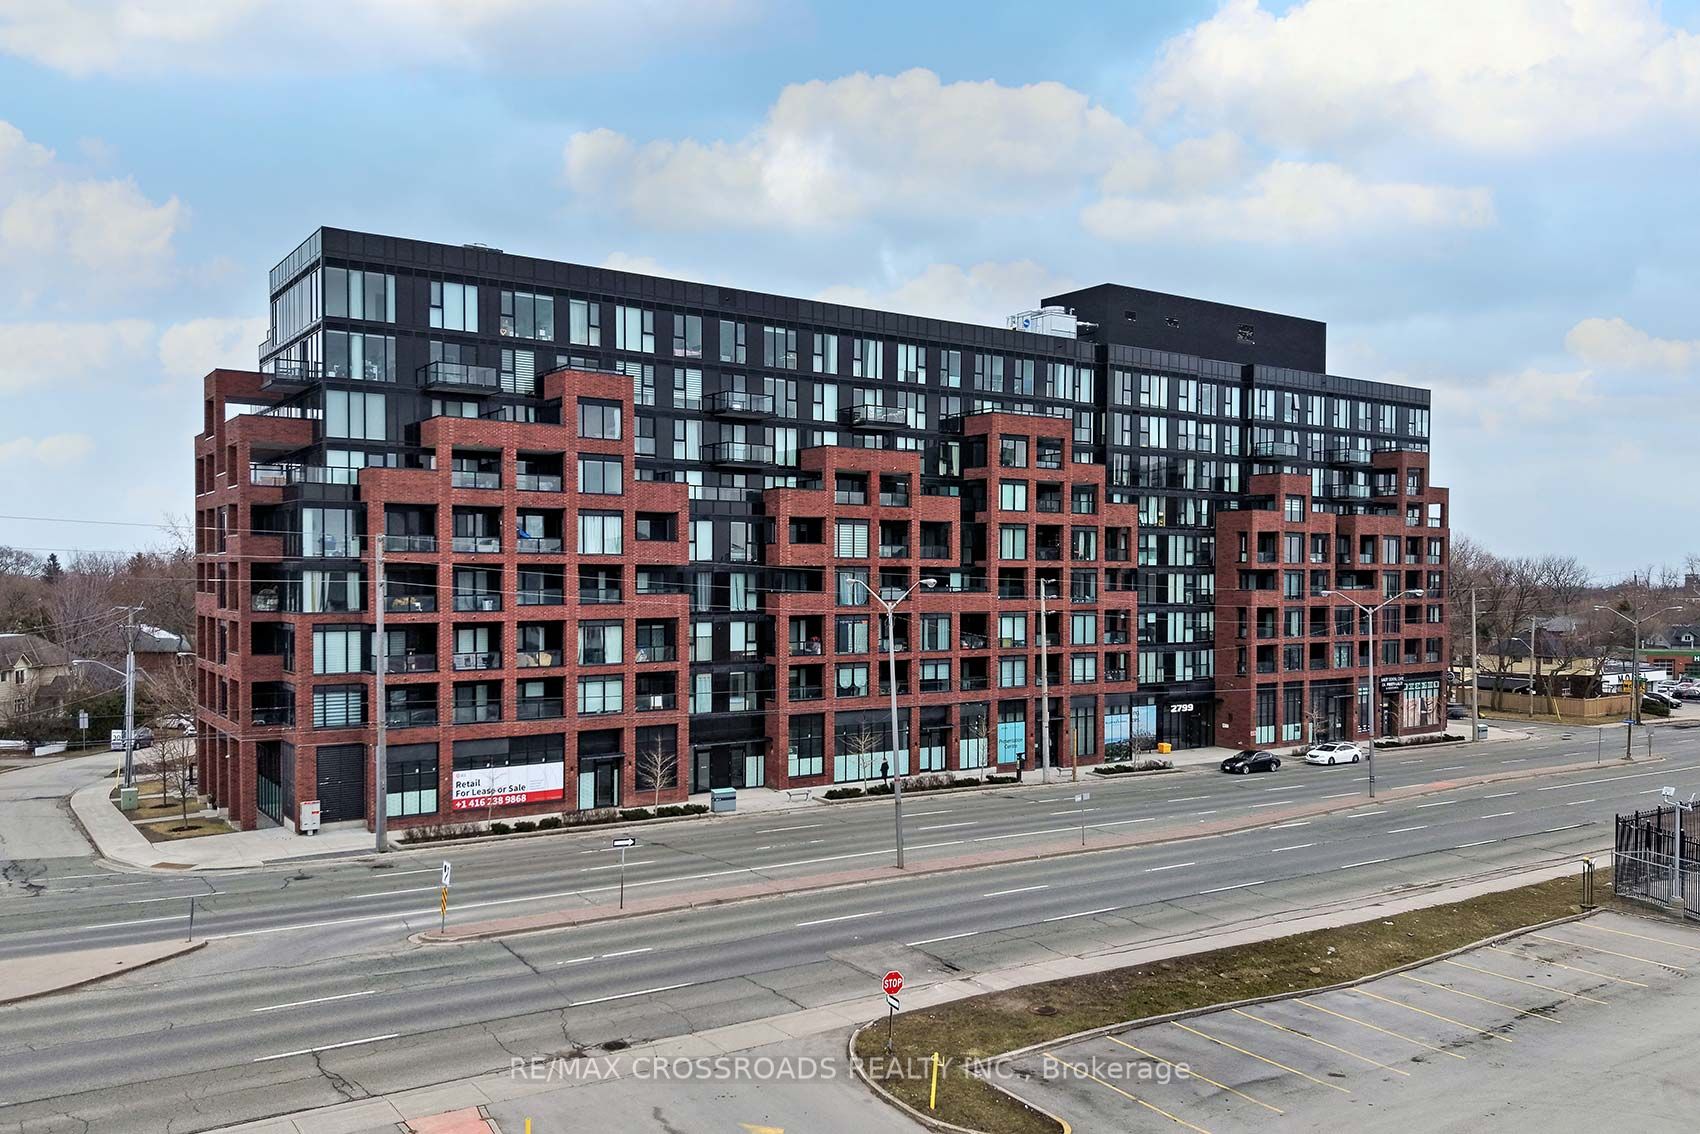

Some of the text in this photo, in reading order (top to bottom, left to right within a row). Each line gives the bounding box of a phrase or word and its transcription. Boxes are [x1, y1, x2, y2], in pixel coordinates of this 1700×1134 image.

[1170, 703, 1194, 713] 2799
[455, 779, 481, 789] Retail
[455, 789, 470, 798] For
[471, 787, 496, 797] Lease
[497, 786, 507, 794] or
[508, 783, 526, 793] Sale
[455, 800, 467, 809] +1
[468, 797, 486, 808] 416
[506, 793, 527, 804] 9868
[884, 978, 902, 989] STOP
